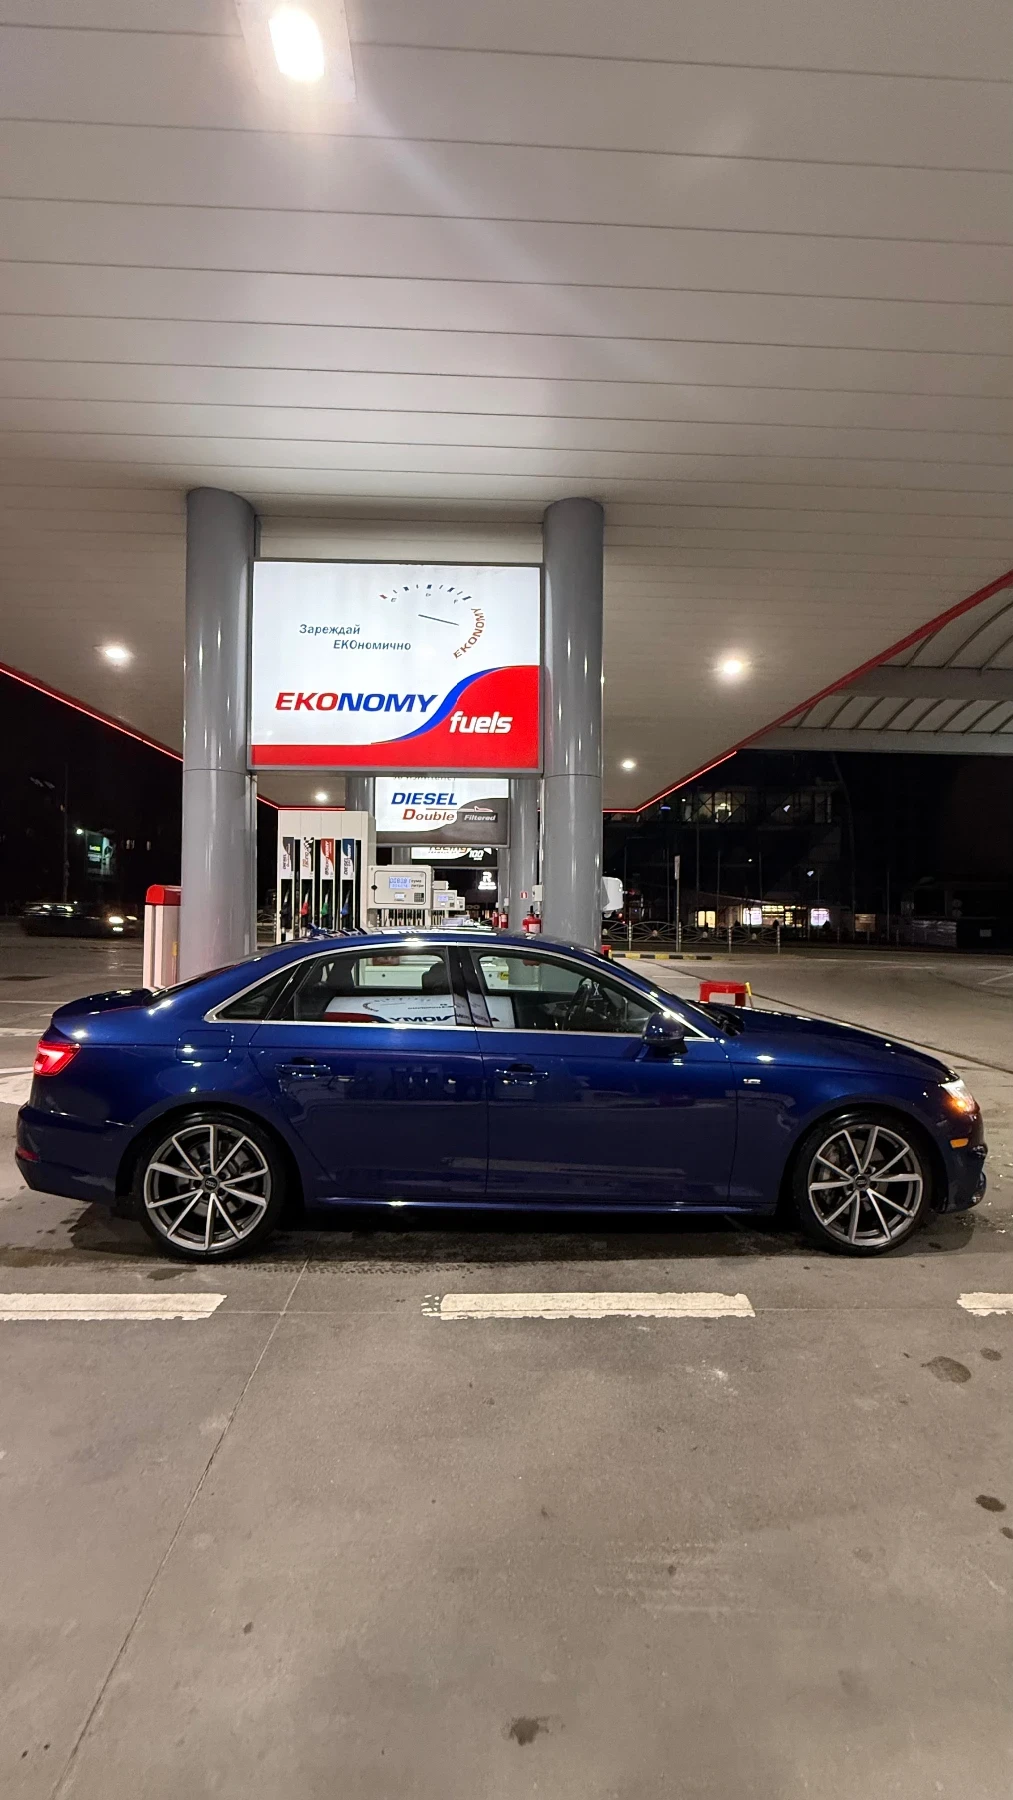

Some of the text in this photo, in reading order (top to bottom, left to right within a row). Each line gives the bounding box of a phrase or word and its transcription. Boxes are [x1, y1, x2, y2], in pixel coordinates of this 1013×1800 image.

[299, 622, 361, 637] Зареждай
[453, 608, 485, 659] EKONOMY
[333, 640, 412, 652] ЕКОномично
[275, 692, 438, 713] EKONOMY
[449, 711, 513, 734] fuels
[390, 792, 458, 805] DIESEL
[403, 808, 497, 822] Double Filtered
[468, 849, 484, 858] 100
